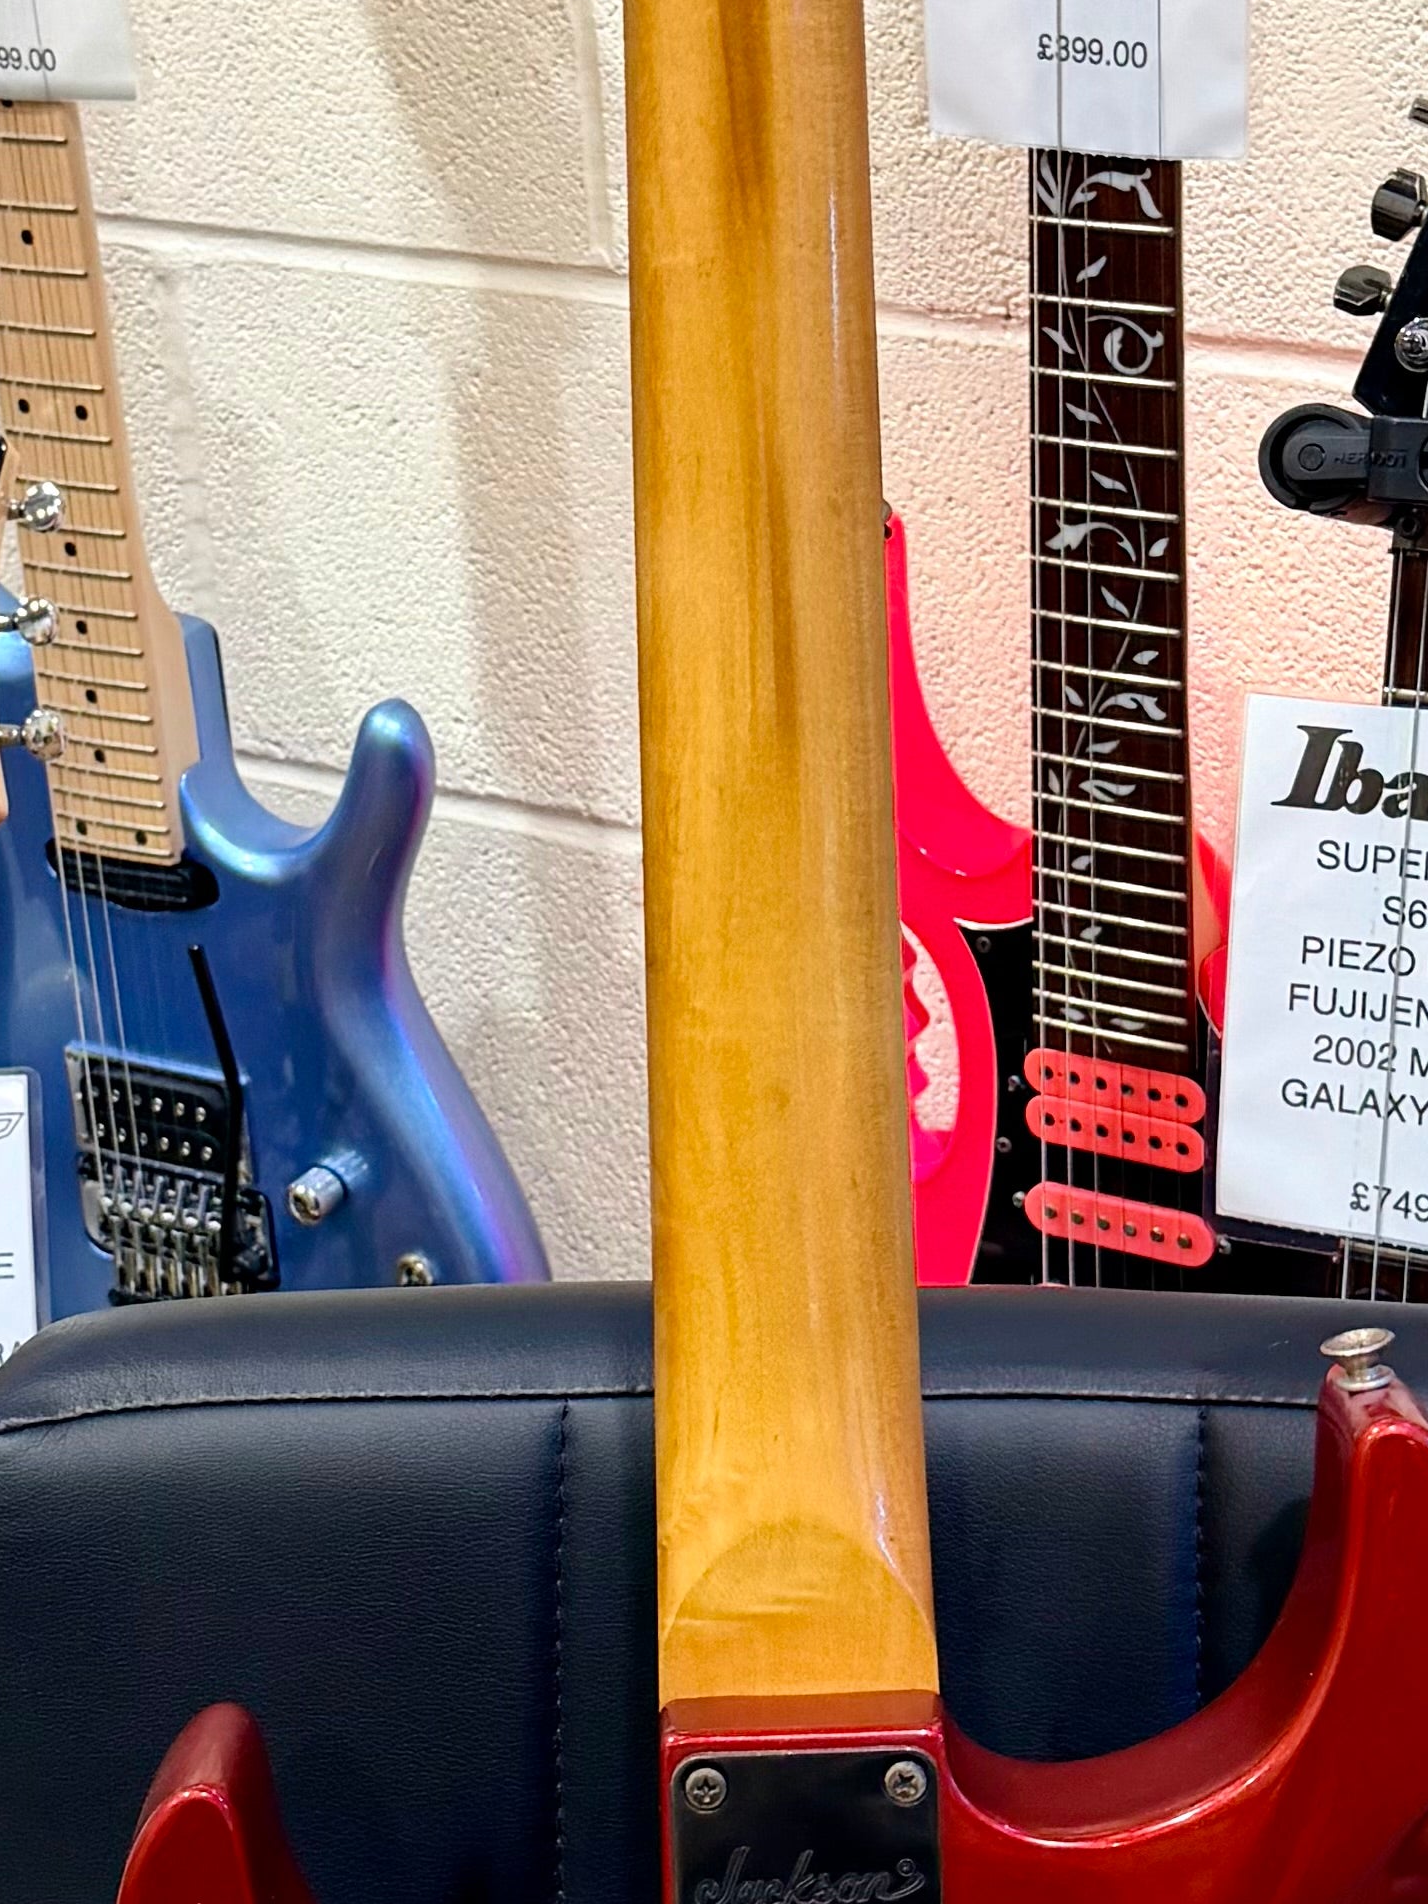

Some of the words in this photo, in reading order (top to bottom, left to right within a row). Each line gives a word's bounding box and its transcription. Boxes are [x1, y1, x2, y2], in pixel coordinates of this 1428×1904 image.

[1038, 33, 1148, 69] £399.00
[1301, 936, 1416, 977] PIEZO
[1314, 1035, 1397, 1073] 2002
